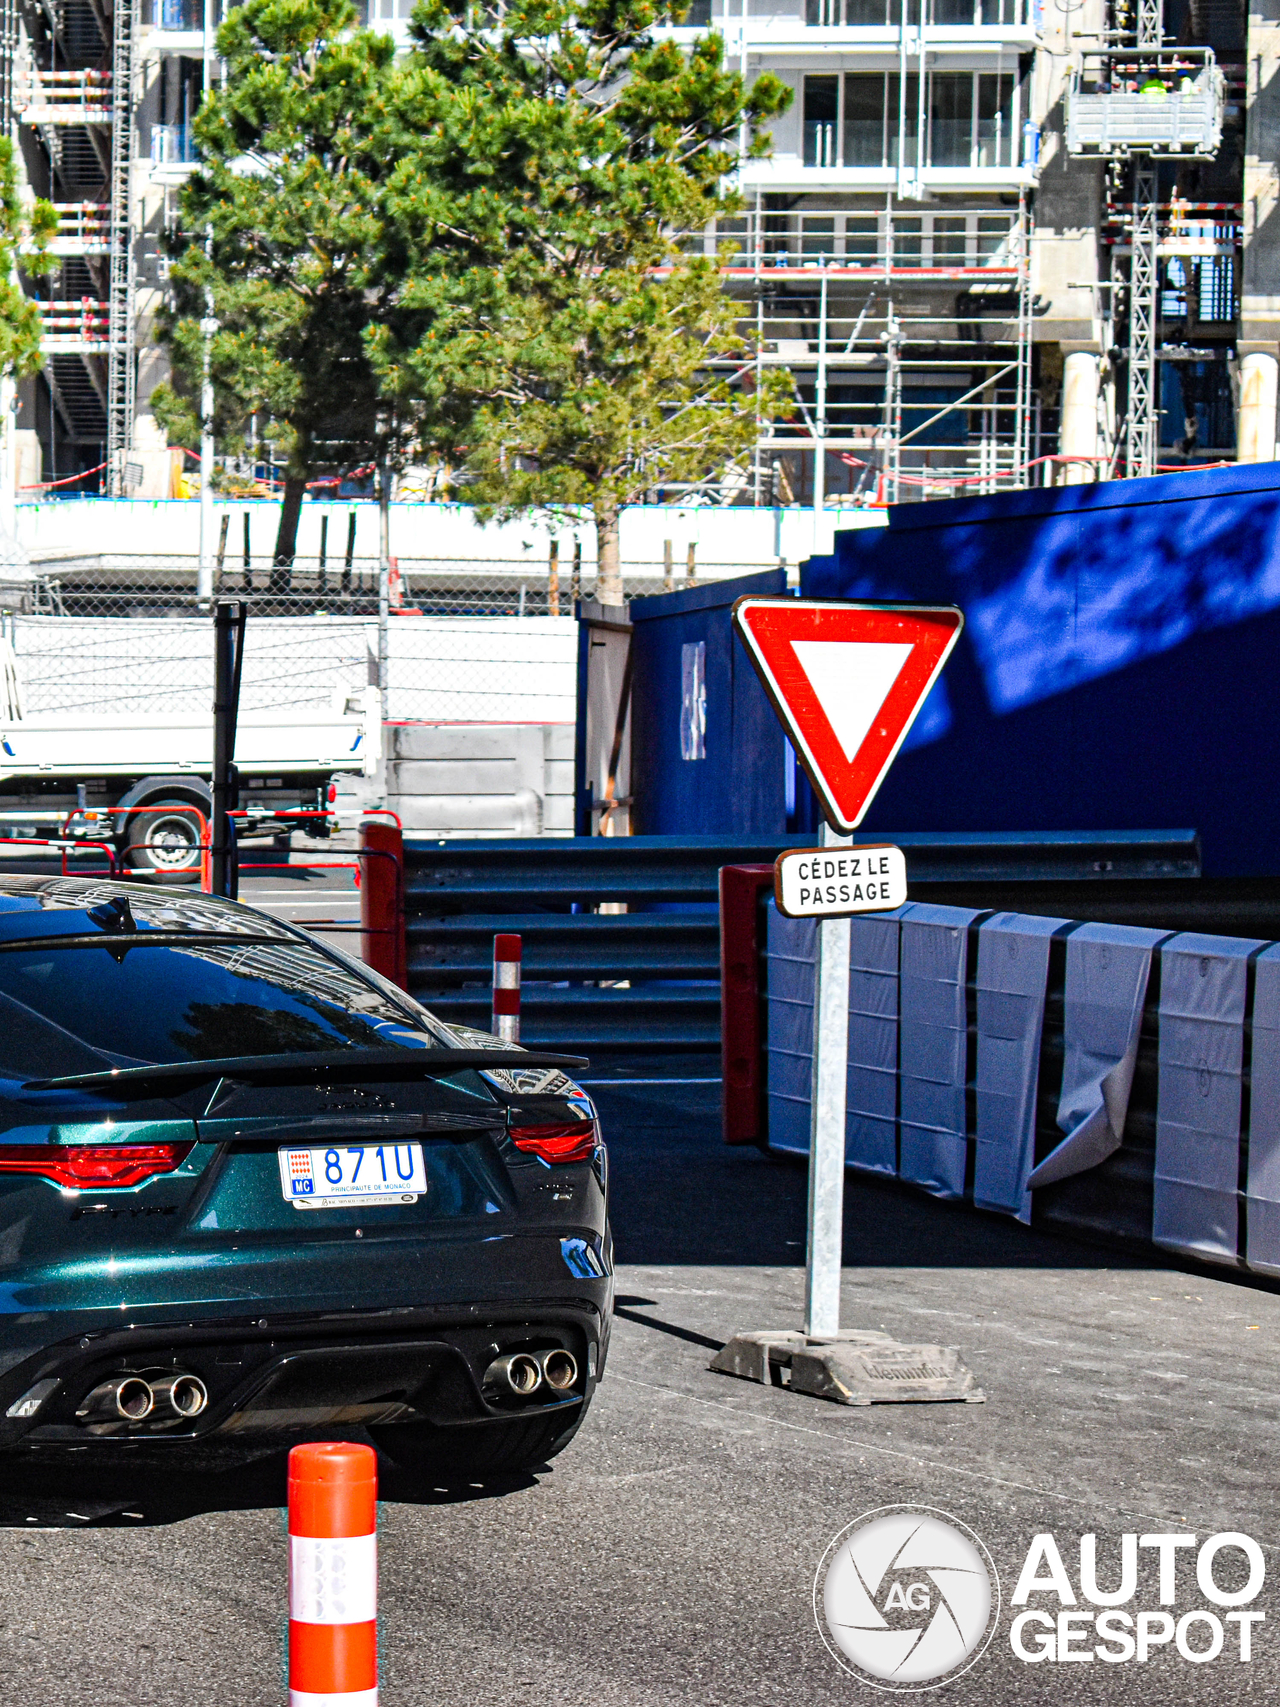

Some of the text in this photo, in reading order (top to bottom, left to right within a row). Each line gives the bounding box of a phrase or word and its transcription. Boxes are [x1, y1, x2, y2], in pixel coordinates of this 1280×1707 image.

[798, 856, 890, 880] CÉDEZ LE
[799, 881, 891, 906] PASSAGE
[324, 1145, 414, 1184] 871U
[295, 1179, 311, 1193] MC
[330, 1182, 412, 1193] PRINCIPAUTE DE MONACO
